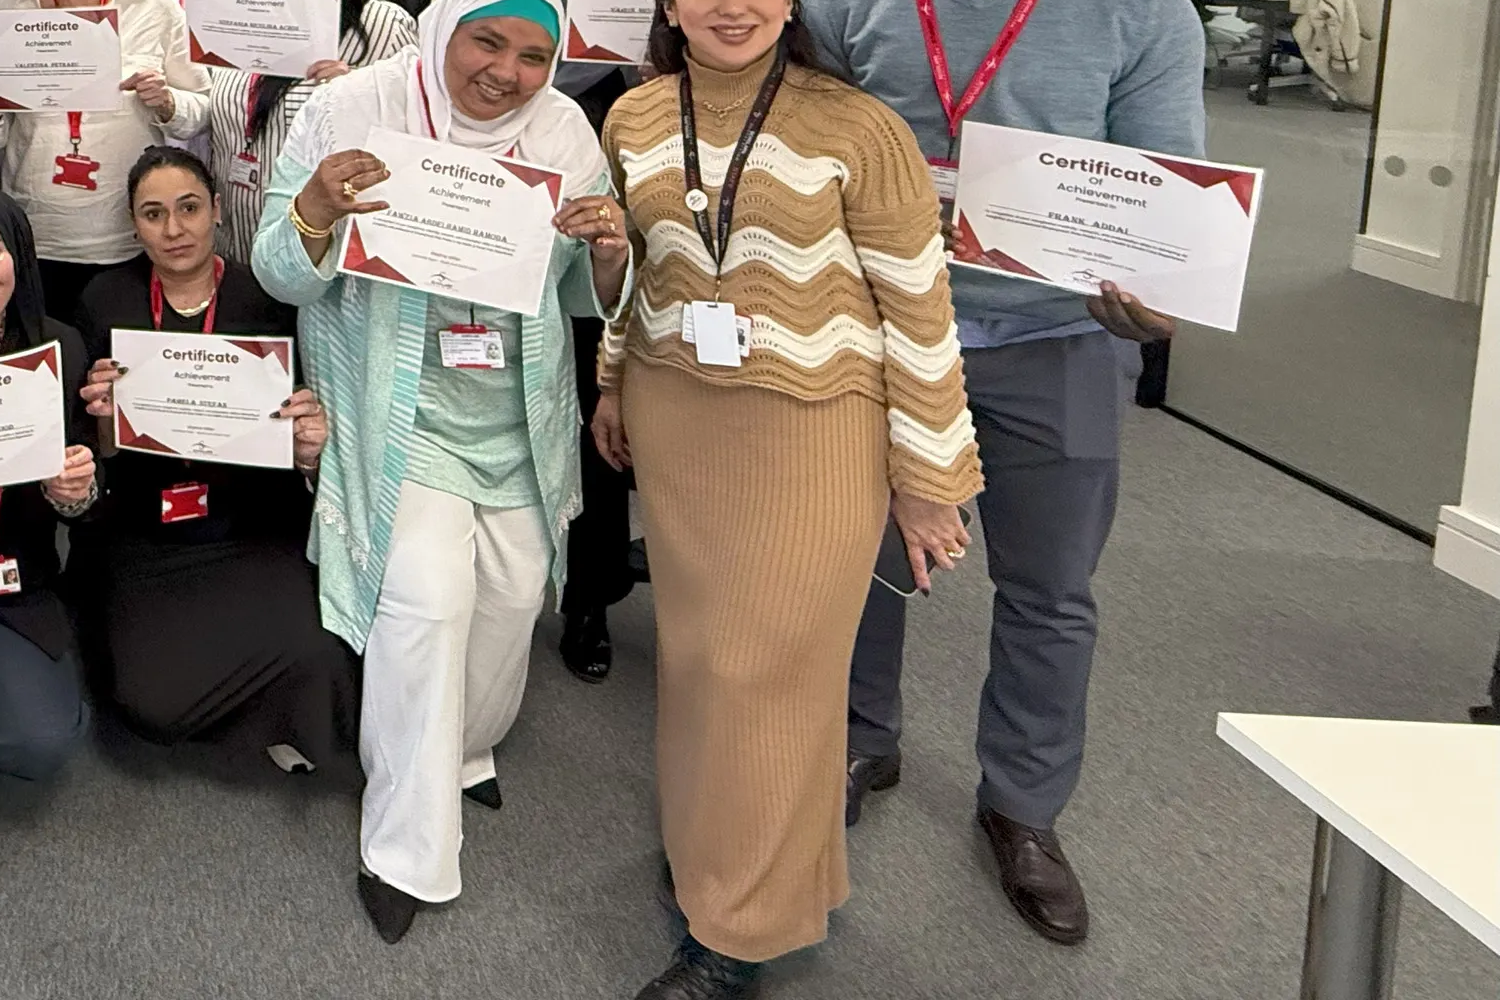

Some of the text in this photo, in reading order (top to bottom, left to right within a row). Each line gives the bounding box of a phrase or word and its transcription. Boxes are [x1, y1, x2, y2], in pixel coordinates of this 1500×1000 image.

[15, 21, 79, 32] Certificate
[421, 158, 506, 189] Certificate
[1039, 152, 1164, 188] Certificate
[453, 181, 464, 190] Of
[1088, 177, 1104, 186] Of
[429, 186, 492, 208] Achievement
[1056, 182, 1147, 209] Achievement
[1048, 211, 1129, 235] FRANK ADDAI
[163, 348, 240, 364] Certificate
[174, 371, 231, 383] Achievement
